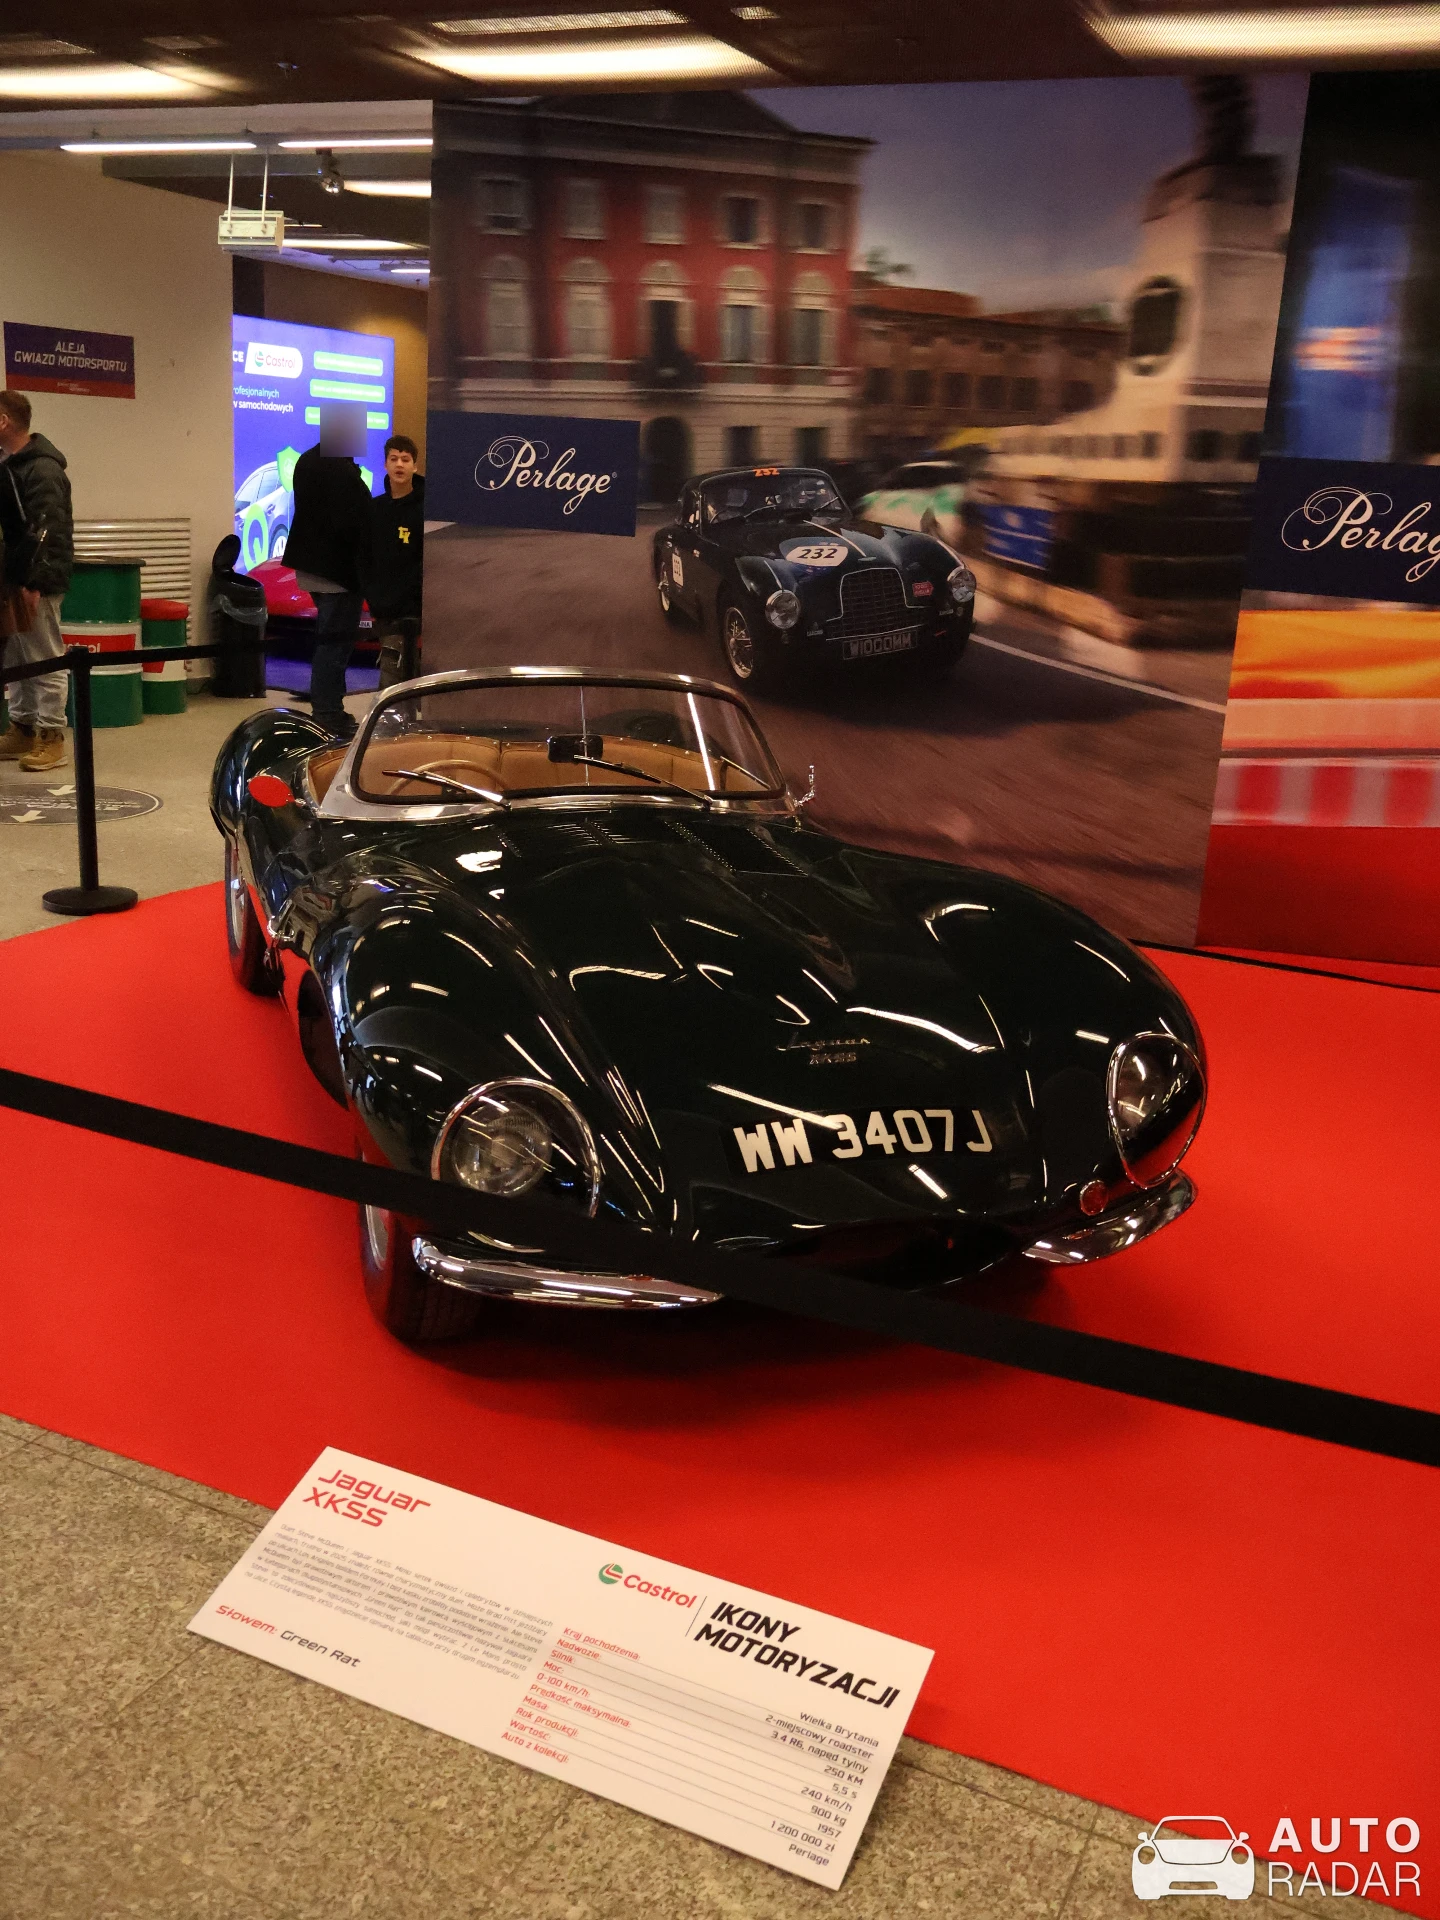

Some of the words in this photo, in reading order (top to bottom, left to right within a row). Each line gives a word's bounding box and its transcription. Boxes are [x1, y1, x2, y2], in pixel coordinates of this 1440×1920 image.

[55, 341, 86, 355] ALEJA
[265, 354, 296, 370] Castrol
[58, 355, 127, 372] MOTORSPORTU
[238, 400, 294, 414] samochodowych
[475, 436, 612, 515] Perlage
[797, 548, 838, 560] 232
[733, 1118, 813, 1173] WW
[317, 1469, 431, 1513] Jaguar
[302, 1486, 388, 1527] XKSS
[623, 1574, 698, 1608] Castrol
[215, 1605, 278, 1634] Słowem:
[280, 1630, 328, 1654] Green
[329, 1649, 361, 1667] Rat
[710, 1601, 801, 1643] IKONY
[561, 1627, 582, 1640] Kraj
[582, 1634, 641, 1661] pochodzenia:
[542, 1660, 565, 1674] Moc:
[693, 1623, 901, 1709] MOTORYZACJI
[536, 1672, 563, 1687] 0-100
[563, 1681, 591, 1698] km/h:
[528, 1684, 572, 1706] Prędkość
[571, 1700, 633, 1730] maksymalna:
[508, 1718, 552, 1741] Wartość:
[515, 1707, 534, 1719] Rok
[533, 1714, 580, 1738] produkcji:
[763, 1714, 827, 1744] 2-miejscowy
[827, 1737, 874, 1760] roadster
[798, 1712, 833, 1730] Wielka
[833, 1724, 880, 1749] Brytania
[500, 1730, 525, 1746] Auto
[532, 1743, 570, 1765] kolekcji:
[806, 1744, 839, 1763] napęd
[840, 1756, 869, 1774] tylny
[823, 1765, 845, 1779] 250
[846, 1773, 864, 1786] KM
[830, 1782, 849, 1797] 5,5
[800, 1786, 823, 1800] 240
[823, 1794, 853, 1813] km/h
[809, 1805, 832, 1820] 900
[832, 1814, 847, 1827] kg
[816, 1823, 842, 1839] 1957
[776, 1822, 799, 1838] 200
[800, 1831, 822, 1847] 000
[824, 1841, 836, 1852] zł
[787, 1843, 830, 1868] Perlage
